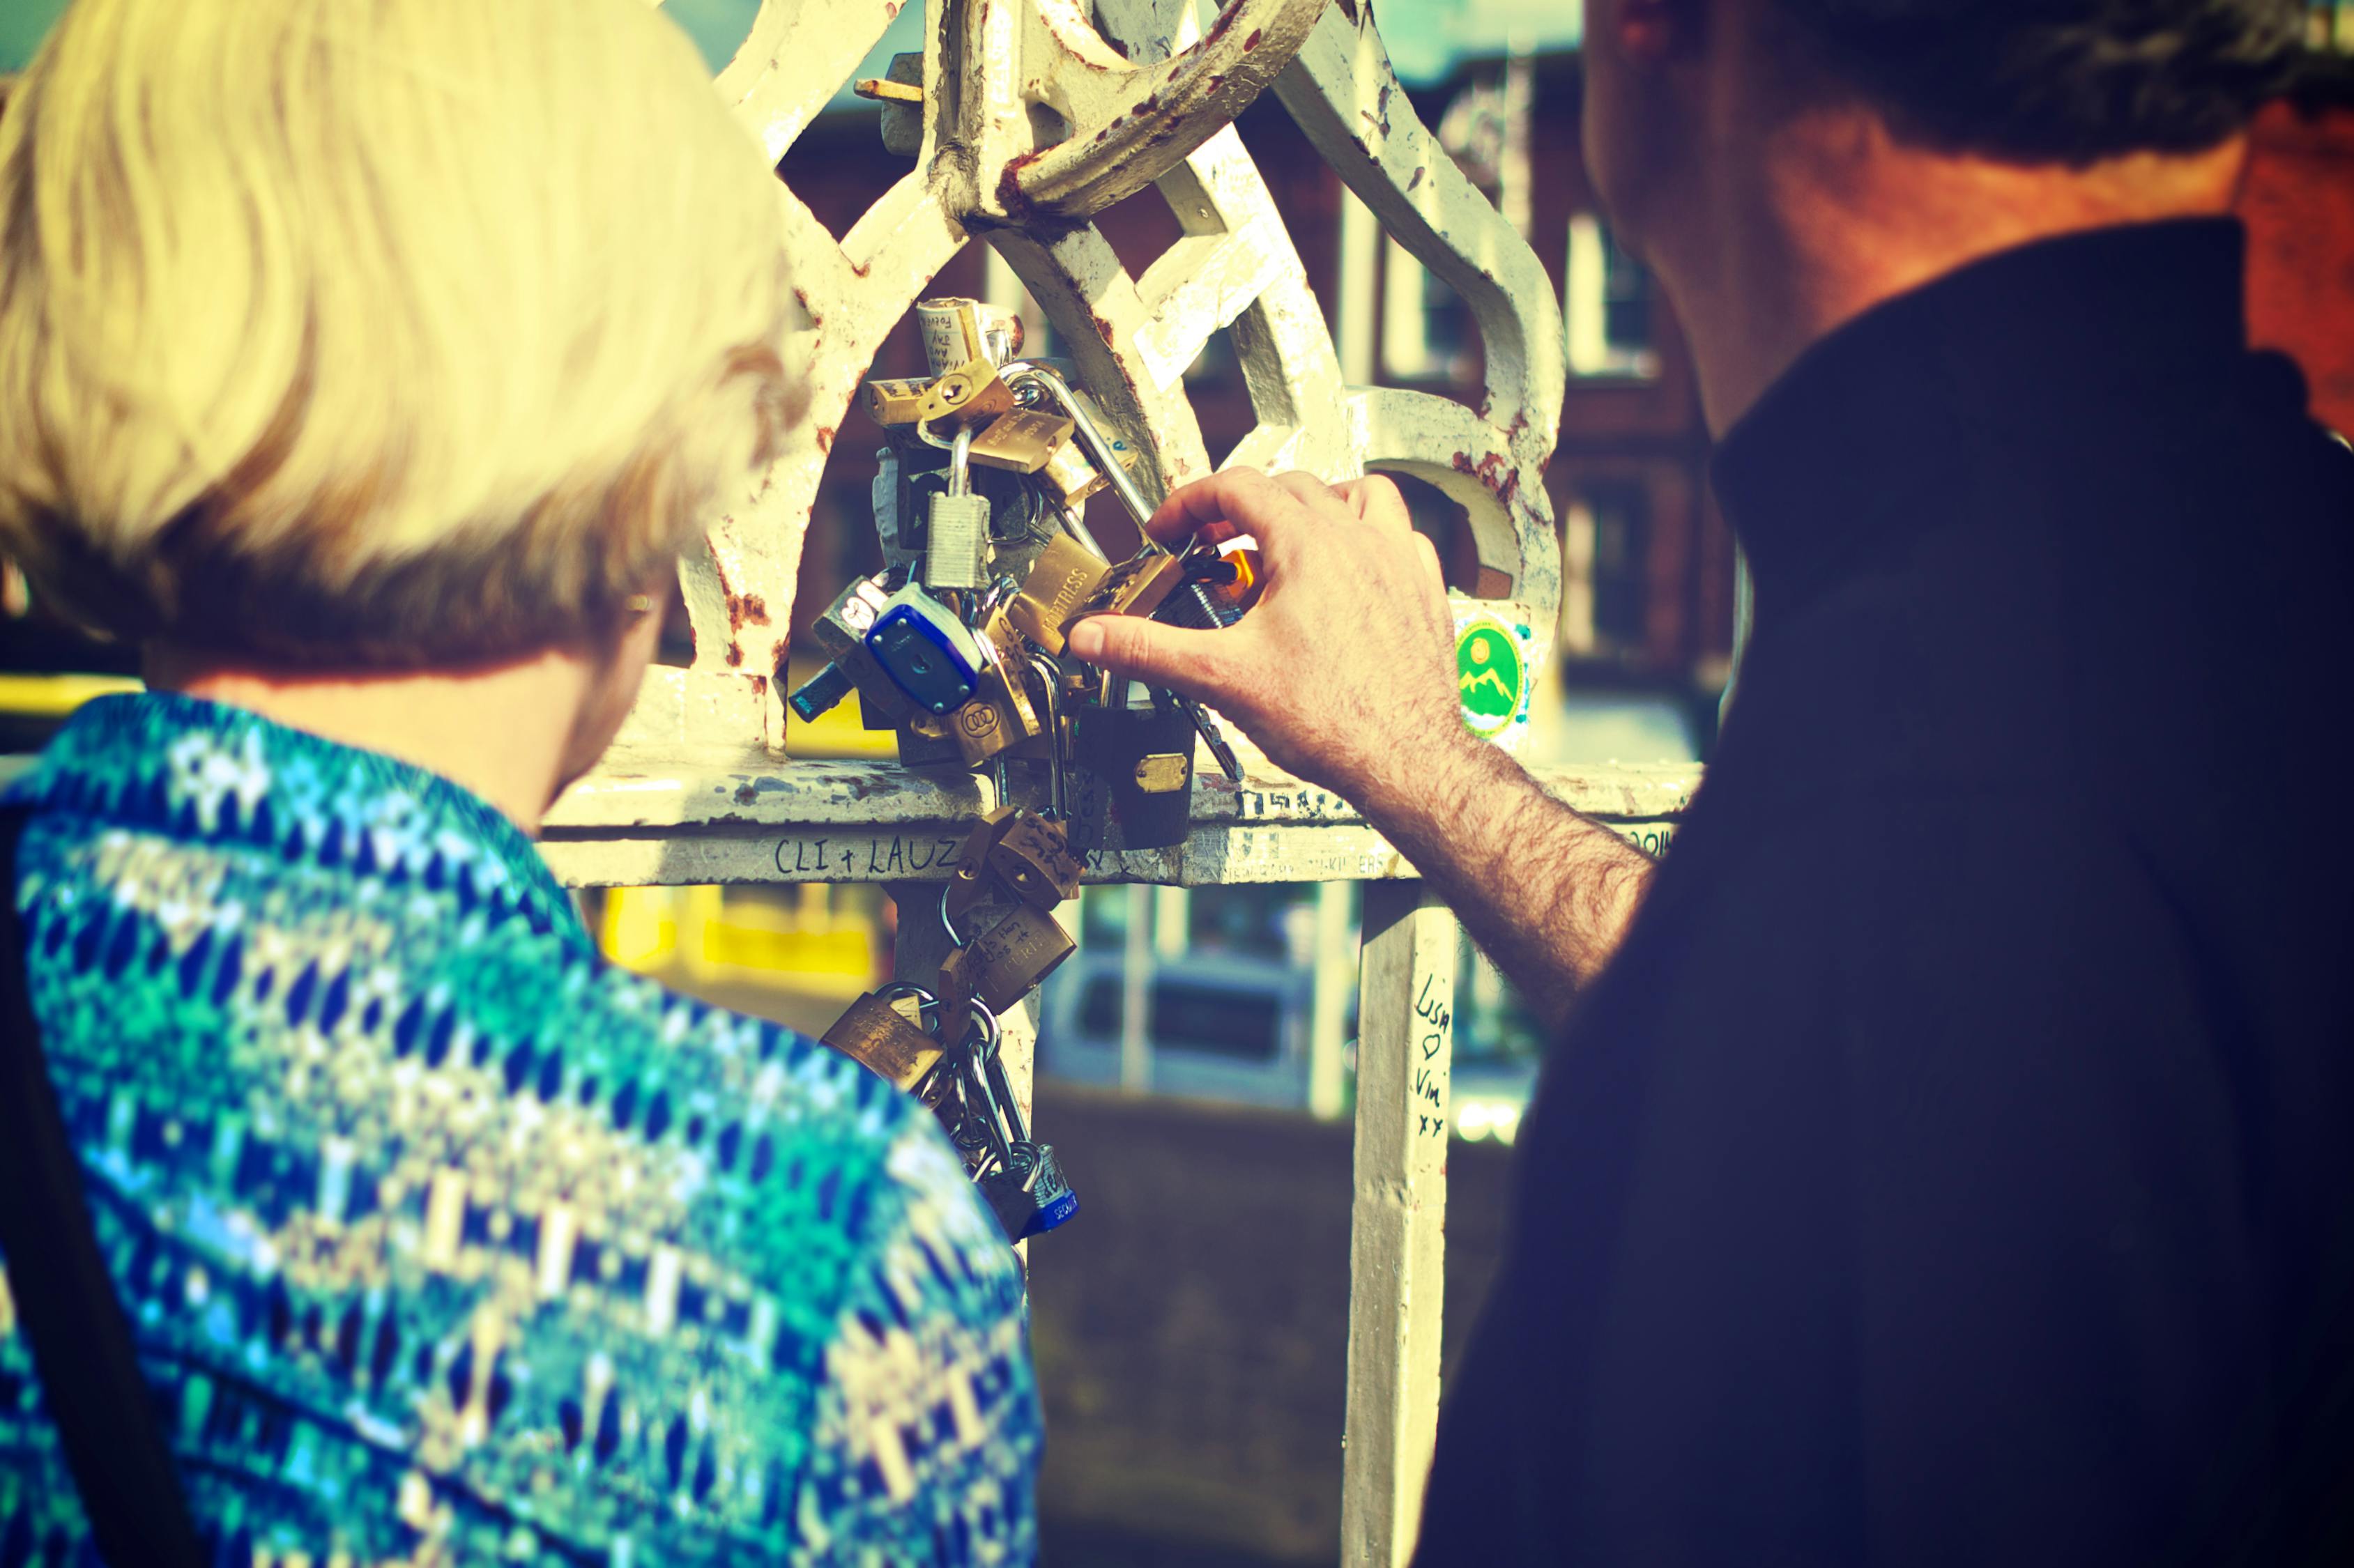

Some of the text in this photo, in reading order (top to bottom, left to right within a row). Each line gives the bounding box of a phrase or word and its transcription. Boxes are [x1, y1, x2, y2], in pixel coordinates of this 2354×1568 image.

[931, 329, 951, 346] JAY
[1041, 567, 1088, 636] FORTRESS
[775, 838, 830, 874] CLI
[841, 849, 855, 873] +
